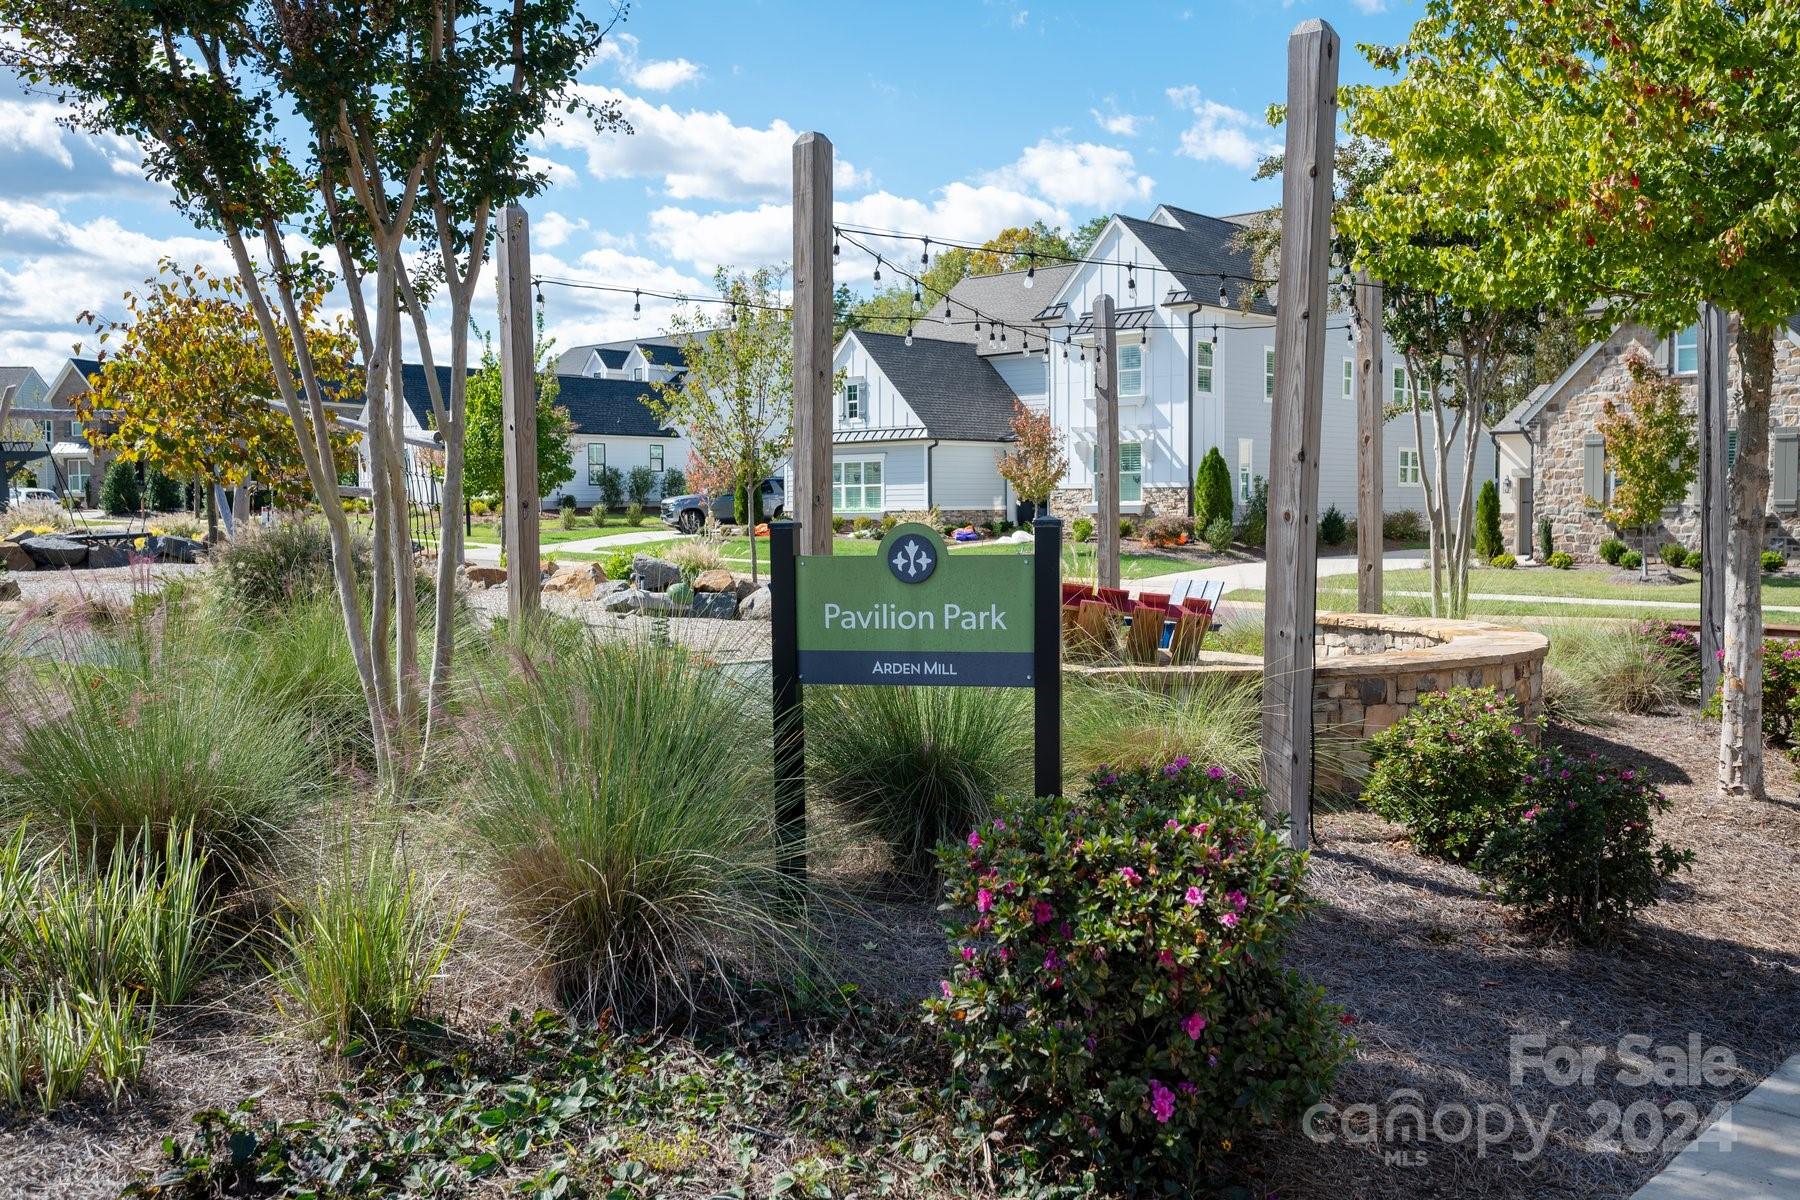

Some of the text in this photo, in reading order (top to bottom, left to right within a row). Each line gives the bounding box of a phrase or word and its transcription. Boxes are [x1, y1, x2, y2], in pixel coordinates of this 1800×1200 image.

[824, 603, 1007, 630] Pavilion Park
[872, 661, 957, 676] ARDEN MILL
